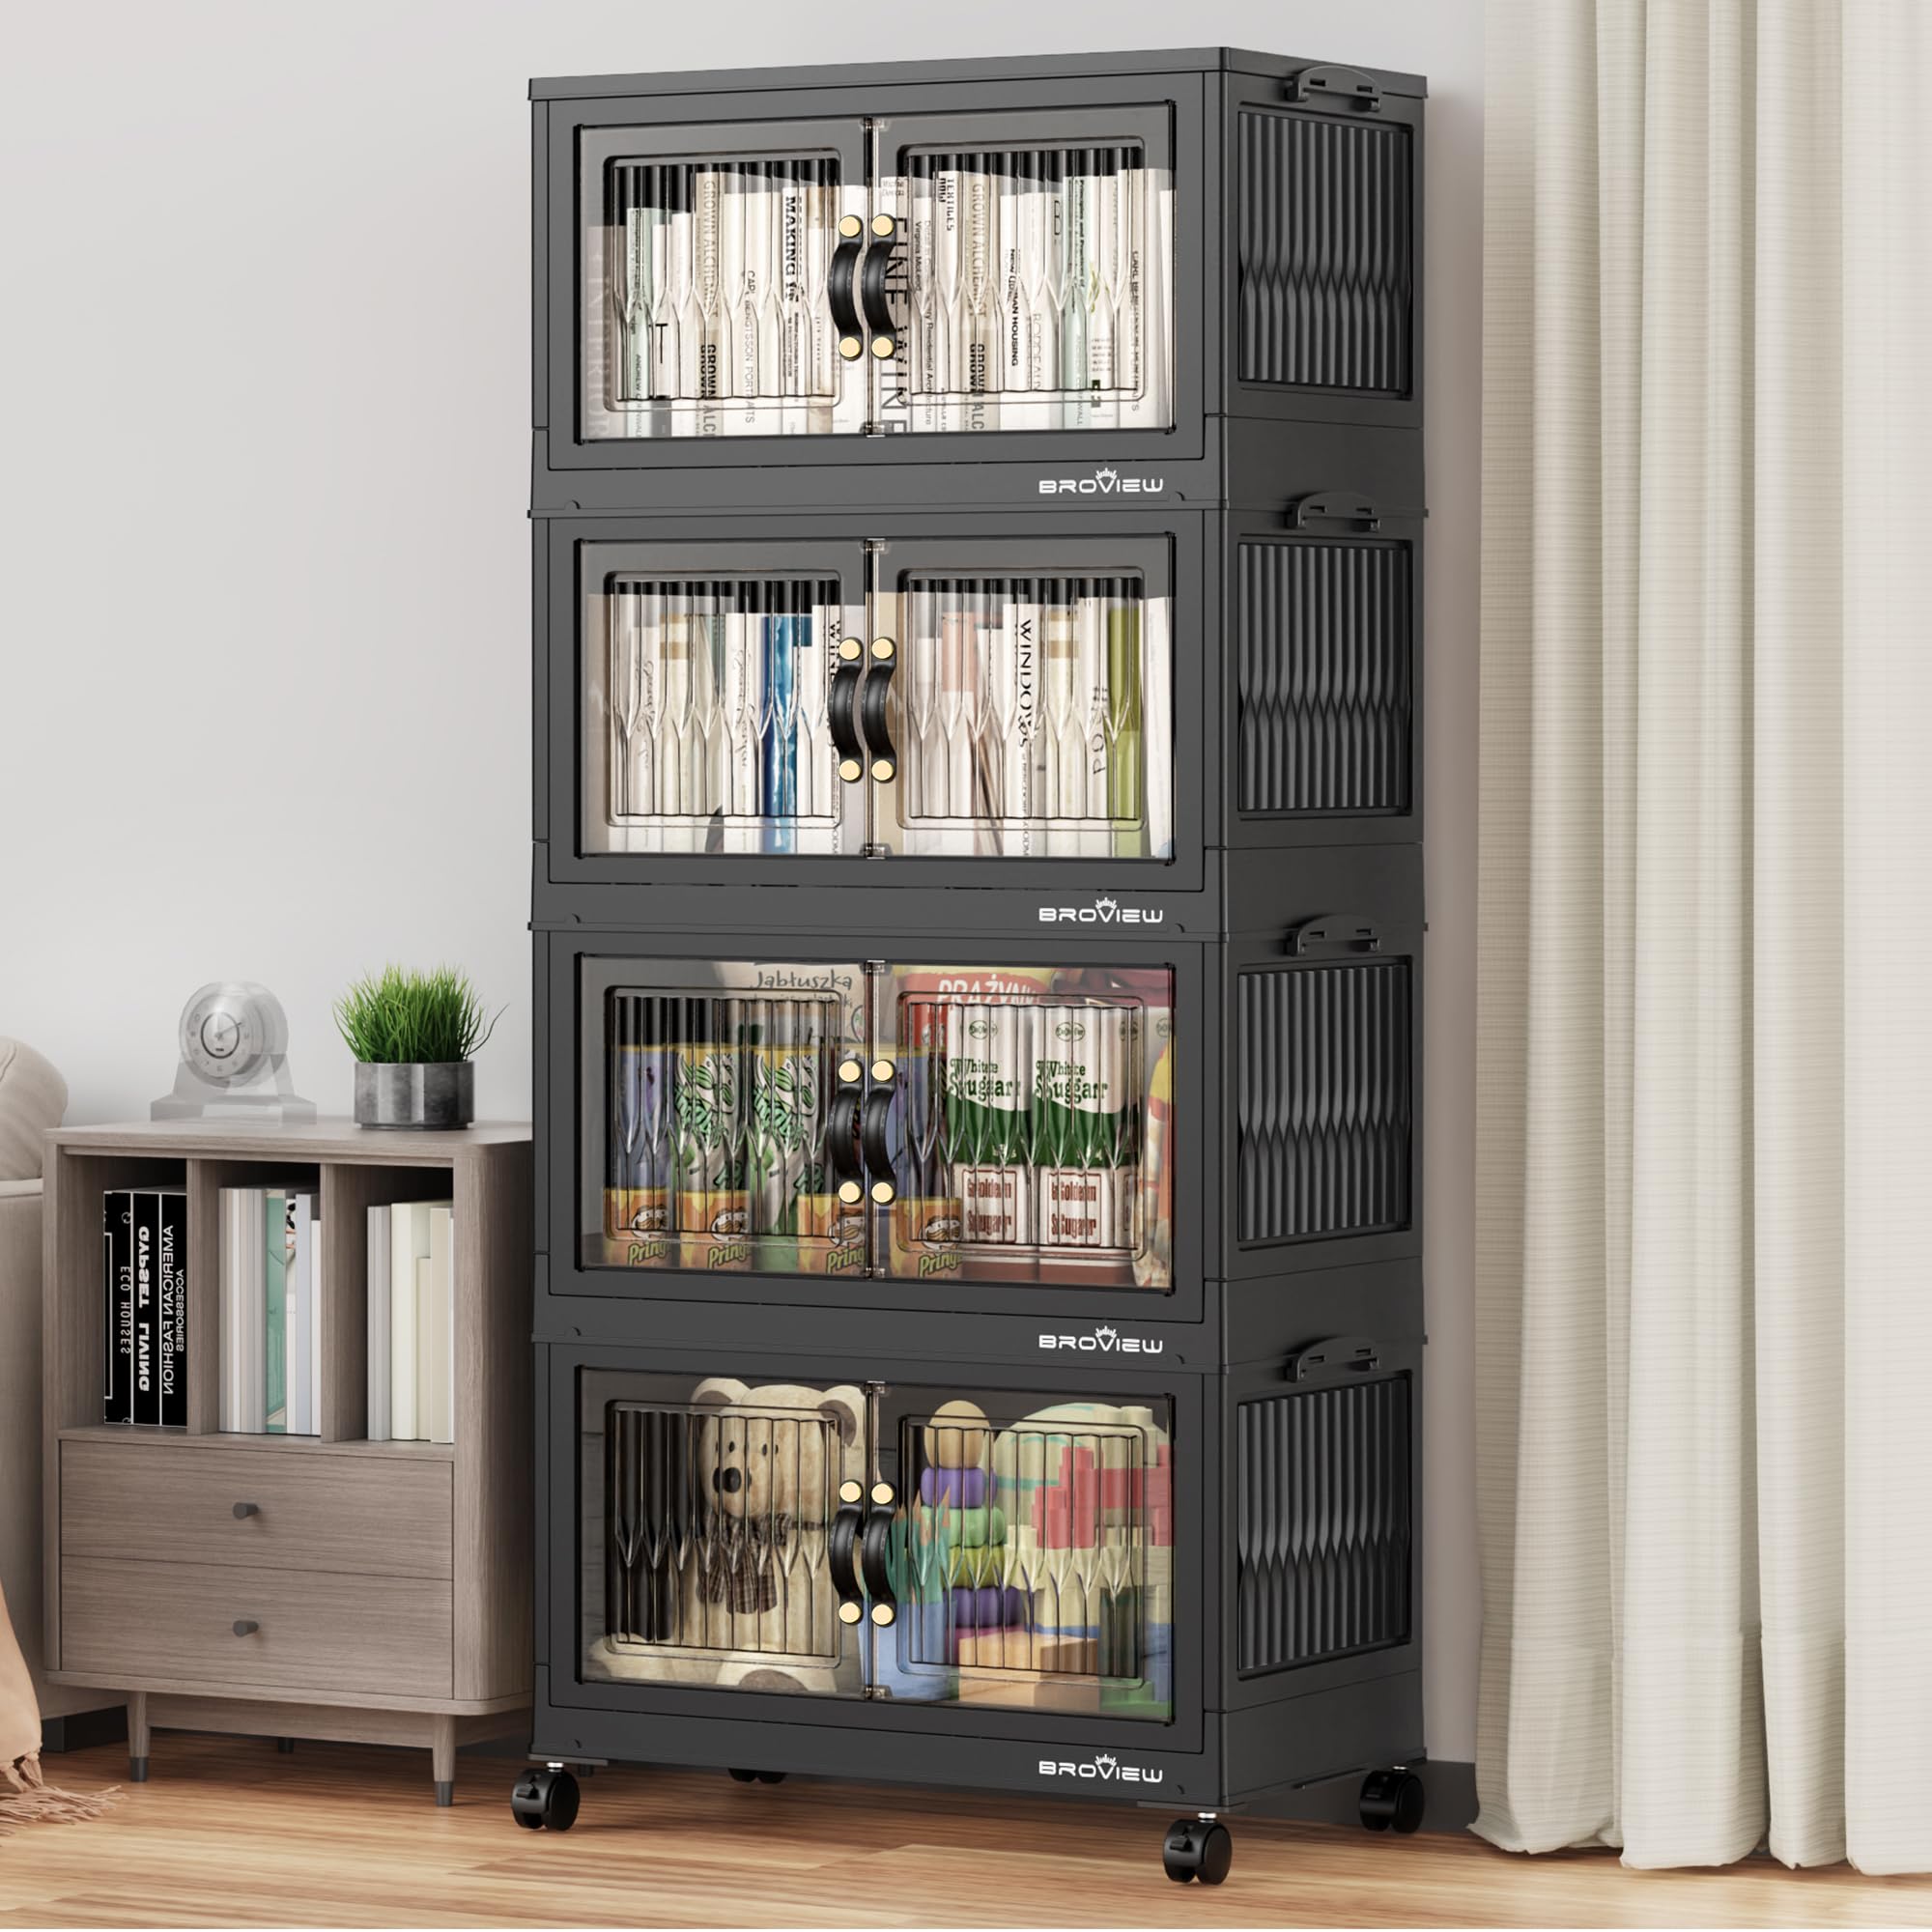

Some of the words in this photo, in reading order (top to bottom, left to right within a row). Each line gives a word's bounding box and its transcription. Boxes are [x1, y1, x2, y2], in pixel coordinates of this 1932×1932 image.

[703, 181, 717, 234] GROWN
[972, 184, 984, 236] GROWN
[785, 196, 798, 276] MAKING
[1038, 473, 1164, 494] BROVIEW
[1038, 902, 1164, 923] BROVIEW
[1038, 1330, 1164, 1353] BROVIEW
[1038, 1757, 1163, 1783] BROVIEW
